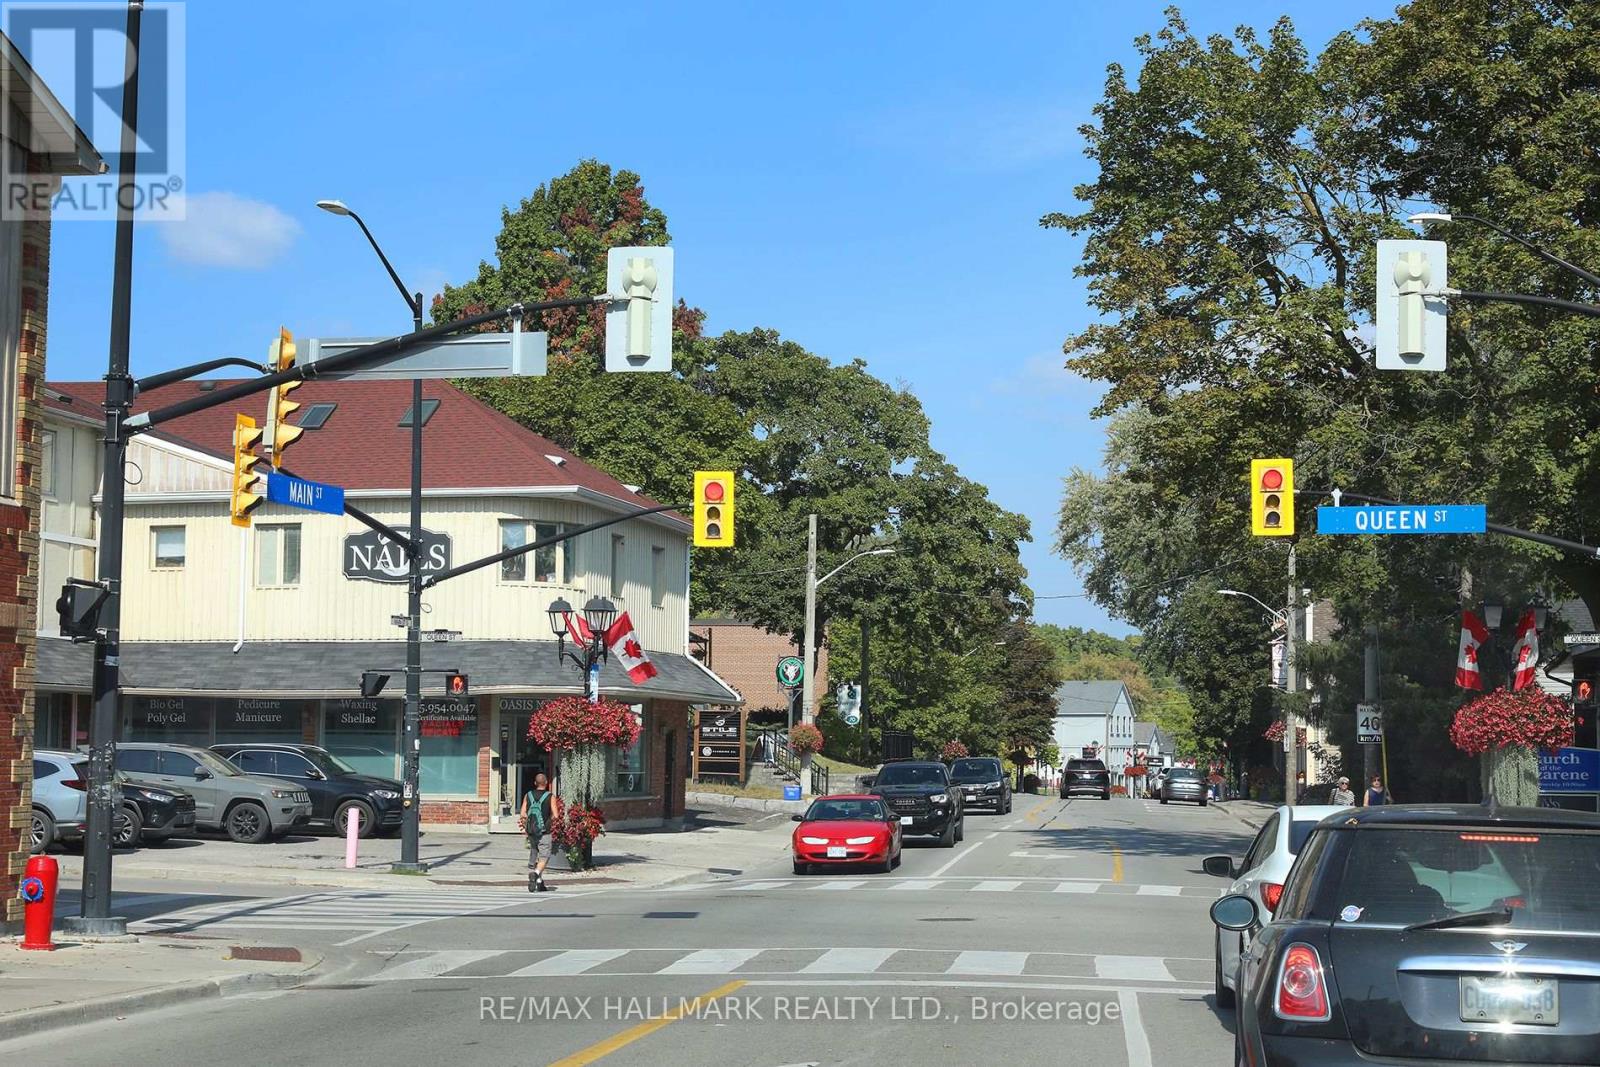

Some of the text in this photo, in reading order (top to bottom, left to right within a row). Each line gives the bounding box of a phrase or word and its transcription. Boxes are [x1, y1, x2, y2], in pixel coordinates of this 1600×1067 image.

[289, 481, 322, 506] MAIN ST
[1355, 510, 1447, 531] QUEEN ST
[150, 699, 184, 709] Bio Gel
[238, 699, 281, 709] Pedicure
[339, 700, 377, 711] Waxing
[500, 699, 534, 710] OASIS
[147, 712, 186, 724] Poly Gel
[235, 712, 282, 722] Manicure
[341, 713, 376, 723] Shellac
[1360, 716, 1380, 731] 40
